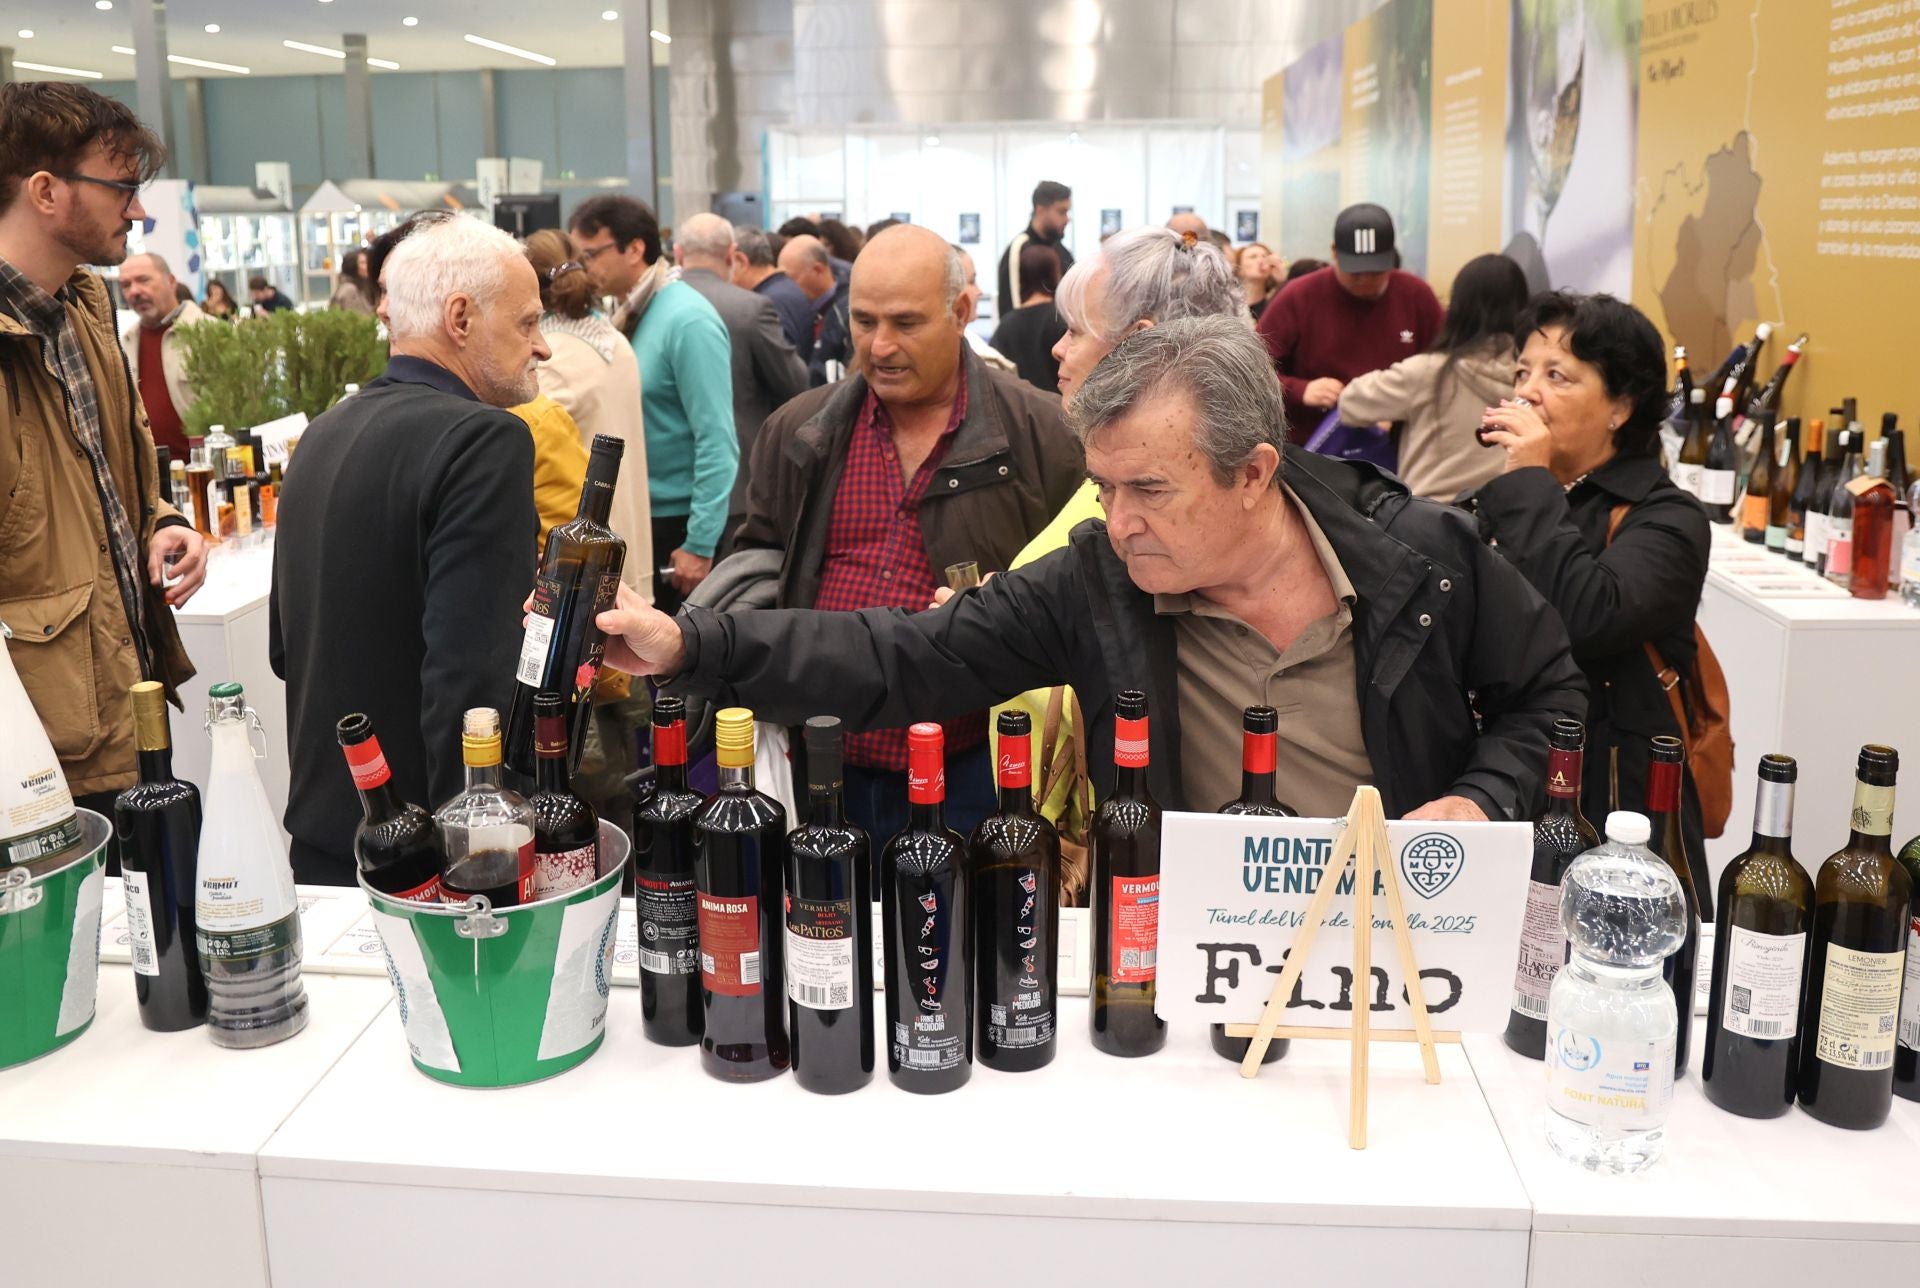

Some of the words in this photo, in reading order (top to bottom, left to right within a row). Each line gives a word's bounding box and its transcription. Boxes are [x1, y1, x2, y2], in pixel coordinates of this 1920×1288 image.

[1243, 866, 1388, 897] VENDMA
[702, 899, 726, 913] ANIMA
[726, 903, 748, 914] ROSA
[799, 902, 837, 912] VERMUT
[1206, 908, 1256, 927] Túnel
[1258, 909, 1289, 927] del
[1289, 912, 1326, 928] Vi
[1329, 911, 1350, 928] de
[1430, 915, 1478, 933] 2025
[1519, 951, 1560, 974] LLANOS
[1820, 1035, 1829, 1046] 75
[1563, 1087, 1595, 1102] FONT
